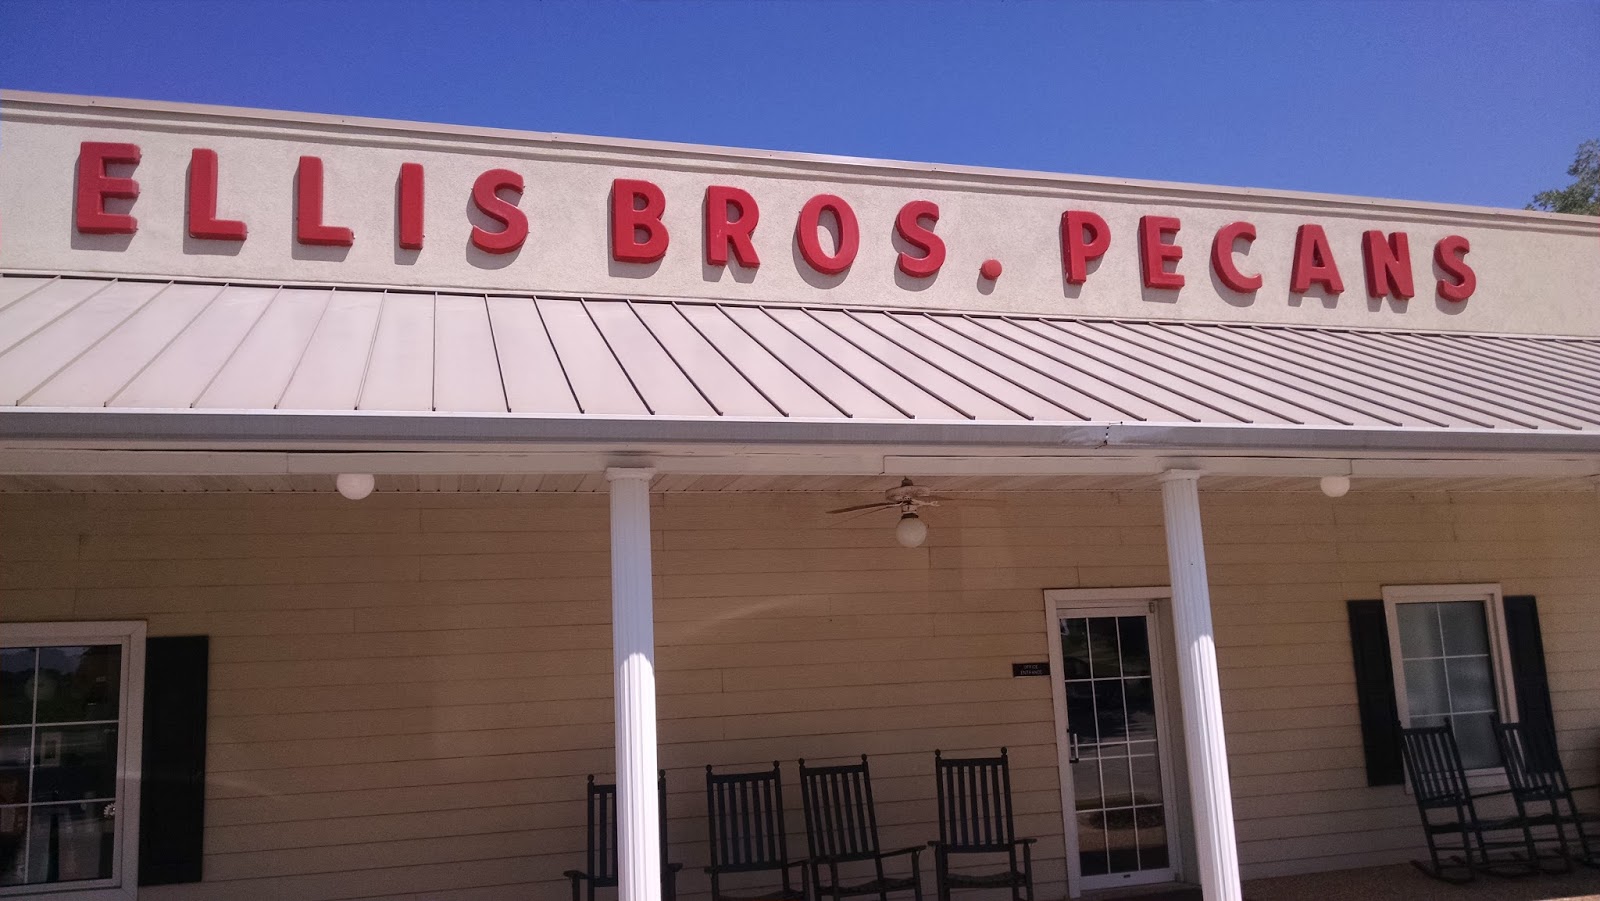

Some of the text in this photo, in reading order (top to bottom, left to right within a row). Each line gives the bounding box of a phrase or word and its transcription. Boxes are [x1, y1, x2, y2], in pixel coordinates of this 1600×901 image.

[76, 141, 1478, 303] ELLIS BROS. PECANS
